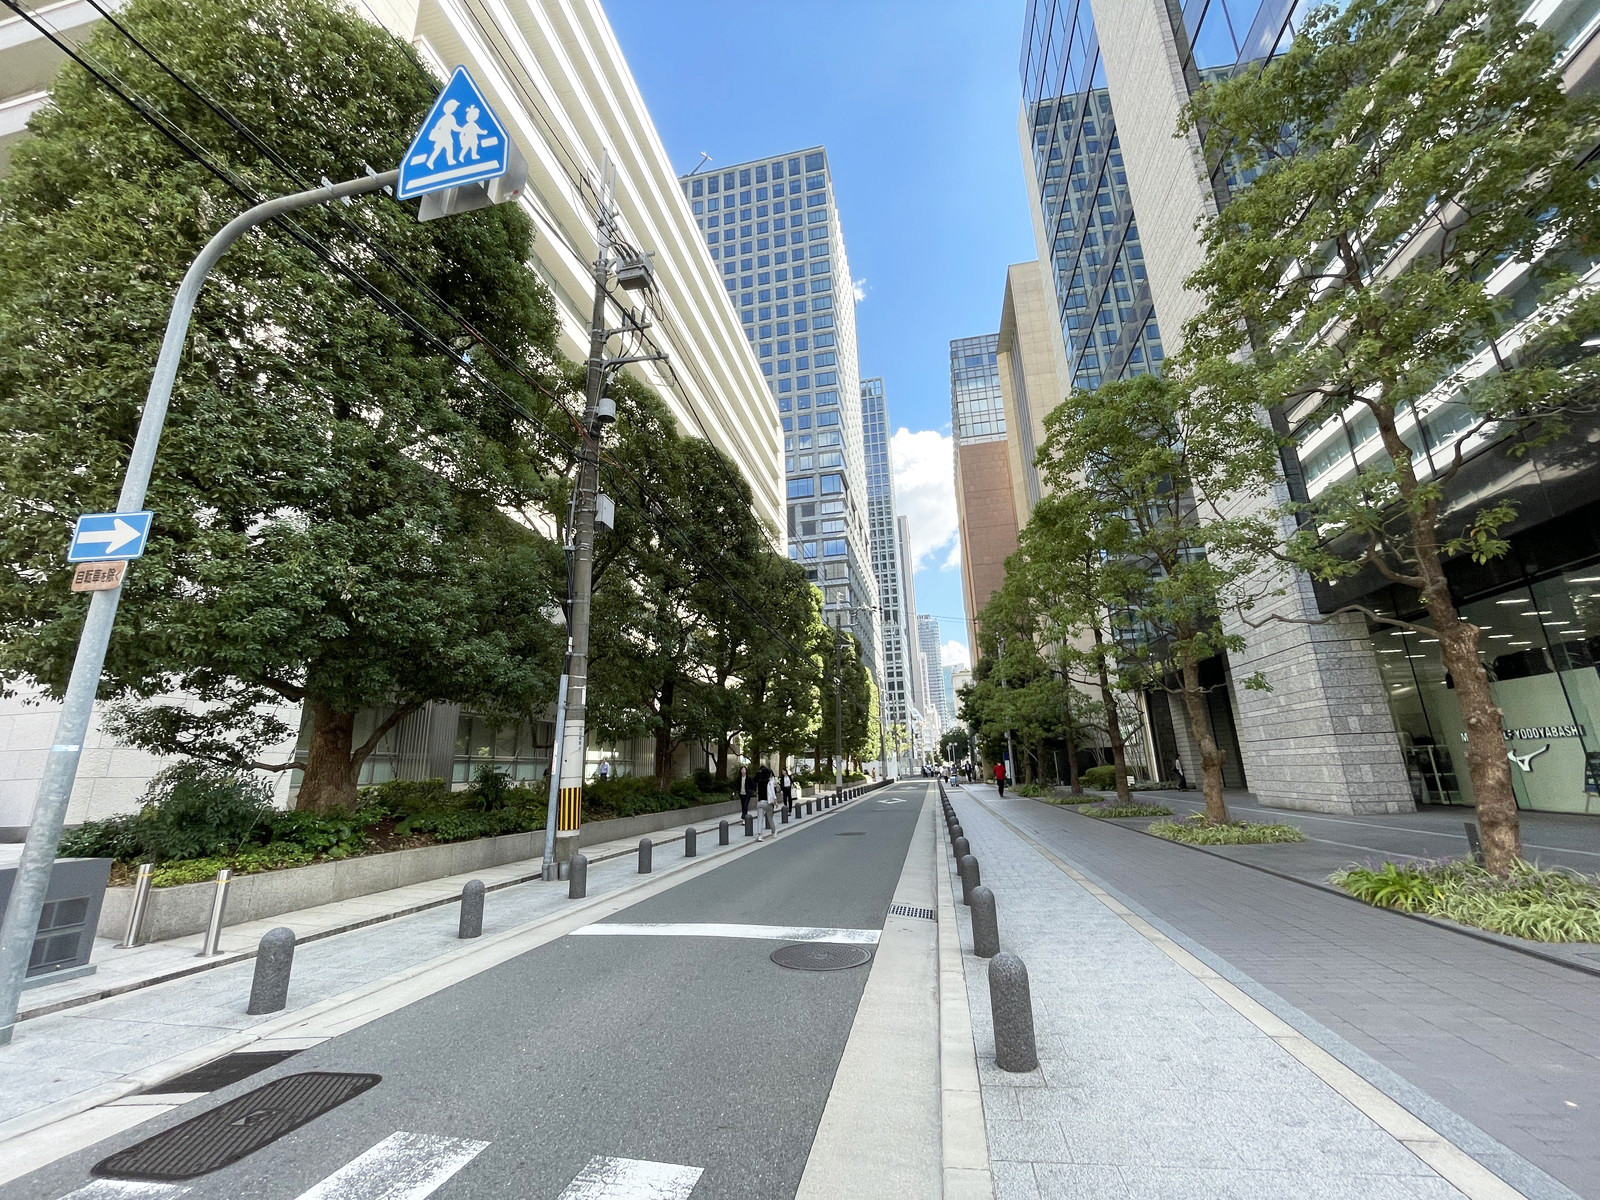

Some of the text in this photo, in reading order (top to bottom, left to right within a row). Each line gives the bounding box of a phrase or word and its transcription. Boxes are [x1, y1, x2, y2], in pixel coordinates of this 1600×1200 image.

[75, 567, 121, 584] 自転車を除く
[1514, 725, 1584, 739] YODOYABASHI
